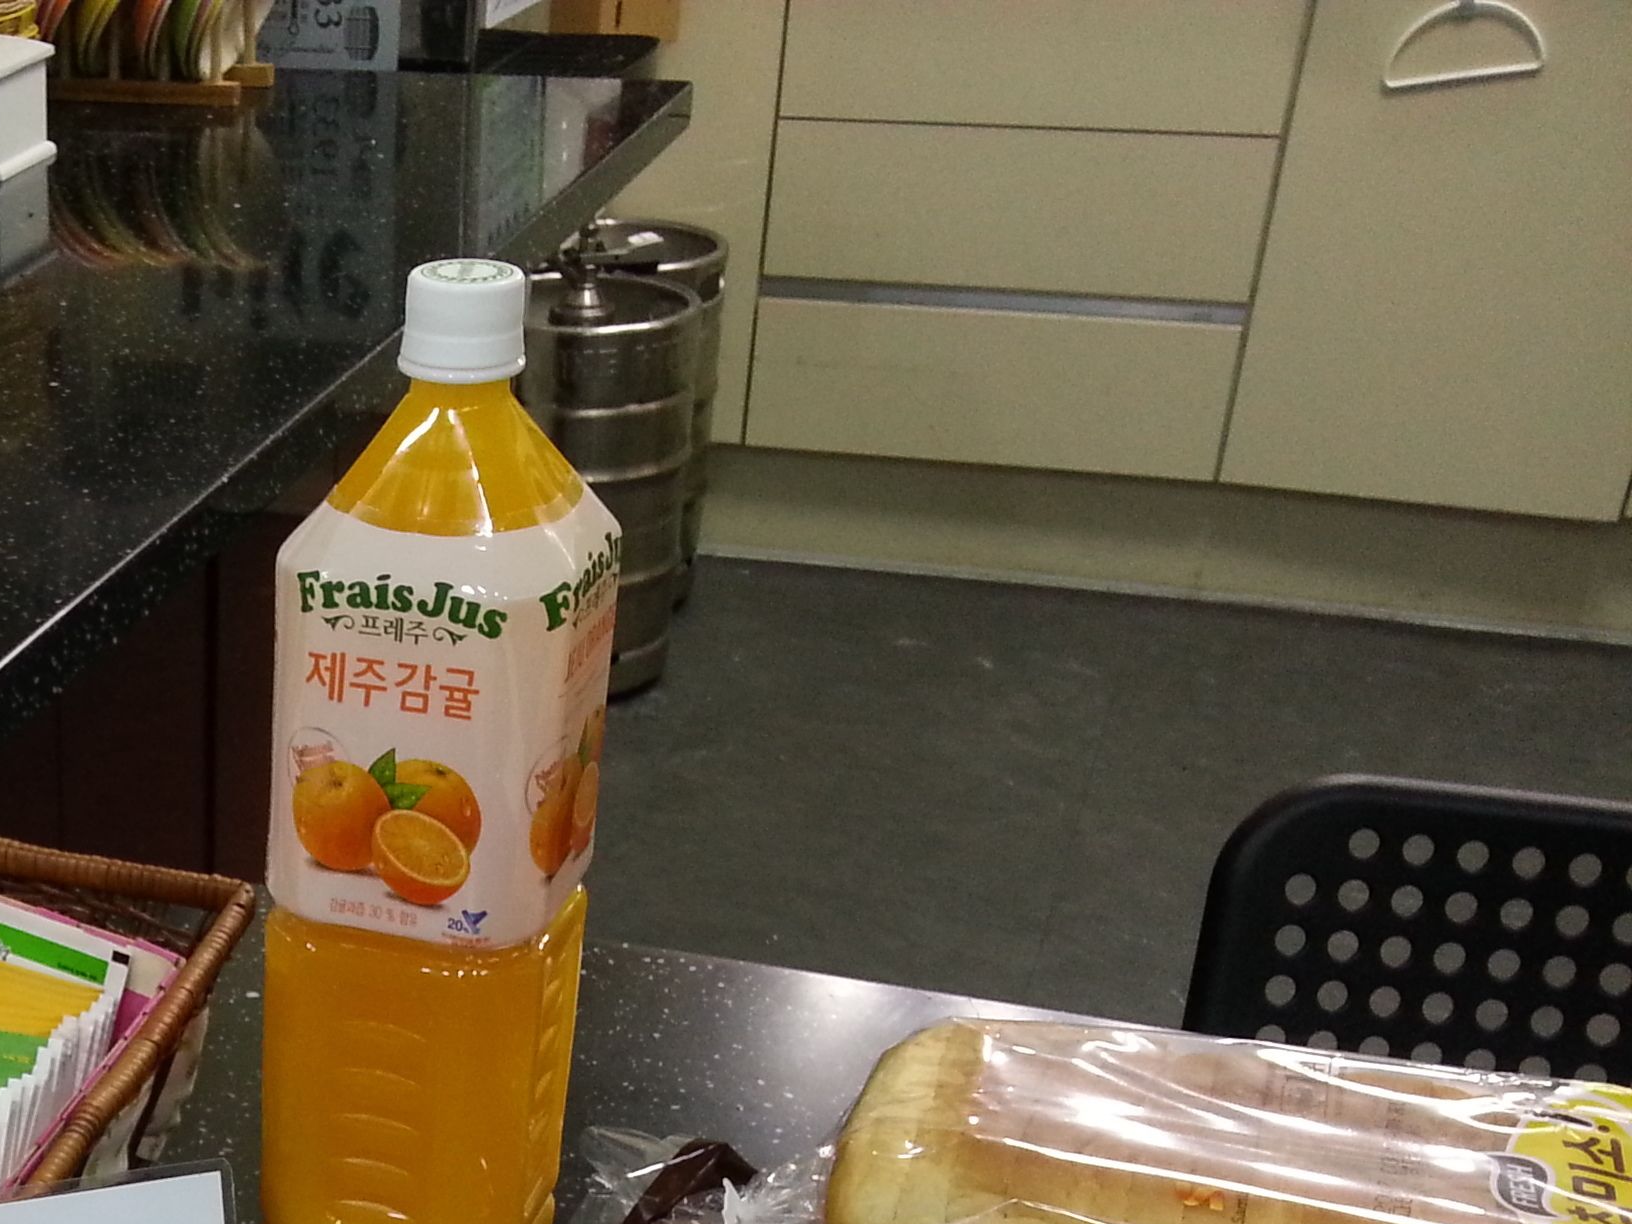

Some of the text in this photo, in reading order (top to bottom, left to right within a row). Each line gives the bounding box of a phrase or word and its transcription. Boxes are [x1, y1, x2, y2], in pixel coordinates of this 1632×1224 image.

[358, 614, 429, 645] 프레주
[305, 651, 480, 721] 제주감귤
[1506, 1161, 1540, 1209] FRESH
